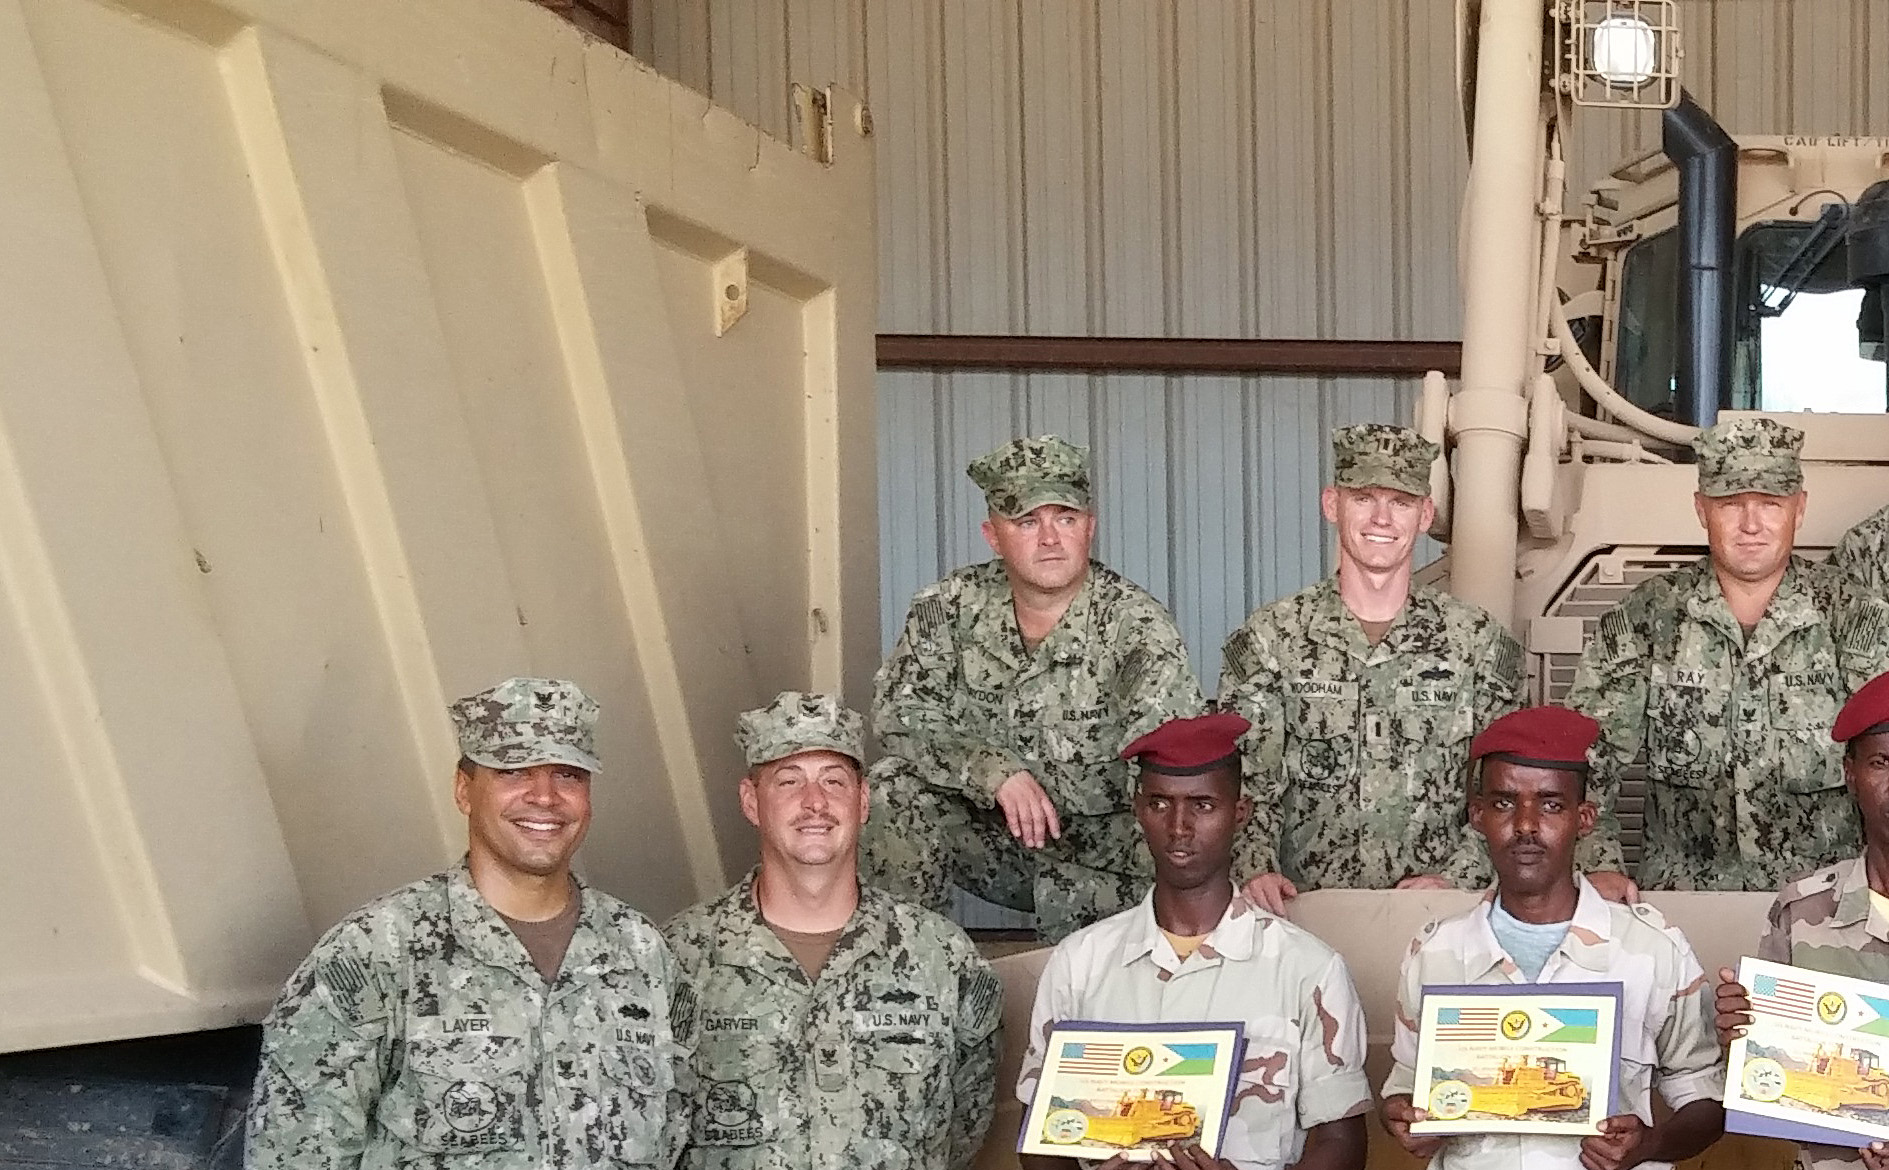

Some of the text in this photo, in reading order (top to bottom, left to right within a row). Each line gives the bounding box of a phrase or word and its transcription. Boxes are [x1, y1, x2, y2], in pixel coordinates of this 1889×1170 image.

[1677, 671, 1705, 684] RAY
[1785, 672, 1835, 687] U.S. NAVY
[1411, 690, 1432, 702] U.S.
[1062, 710, 1079, 721] U.S.
[442, 1018, 490, 1033] LAYER
[705, 1018, 759, 1032] GARVER
[873, 1013, 932, 1027] U.S. NAVY
[615, 1028, 656, 1047] U.S. NAVY
